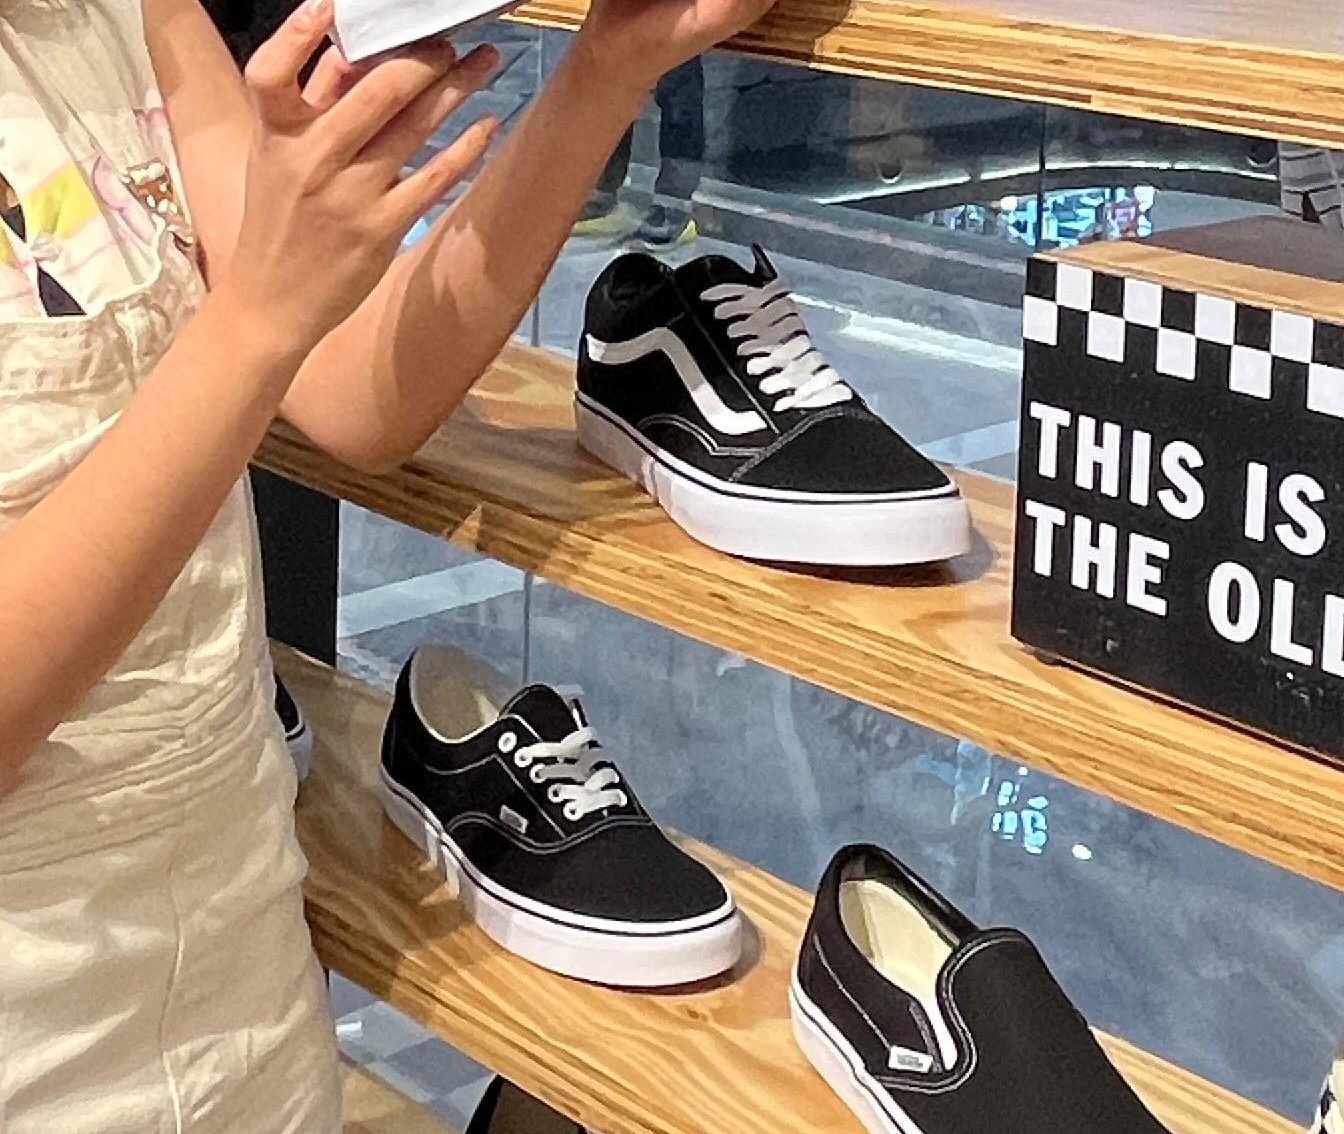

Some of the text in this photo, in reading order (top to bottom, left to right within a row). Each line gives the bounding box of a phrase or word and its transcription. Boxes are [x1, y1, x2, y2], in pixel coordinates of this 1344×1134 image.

[1029, 400, 1328, 557] THIS IS
[1024, 498, 1171, 617] THE
